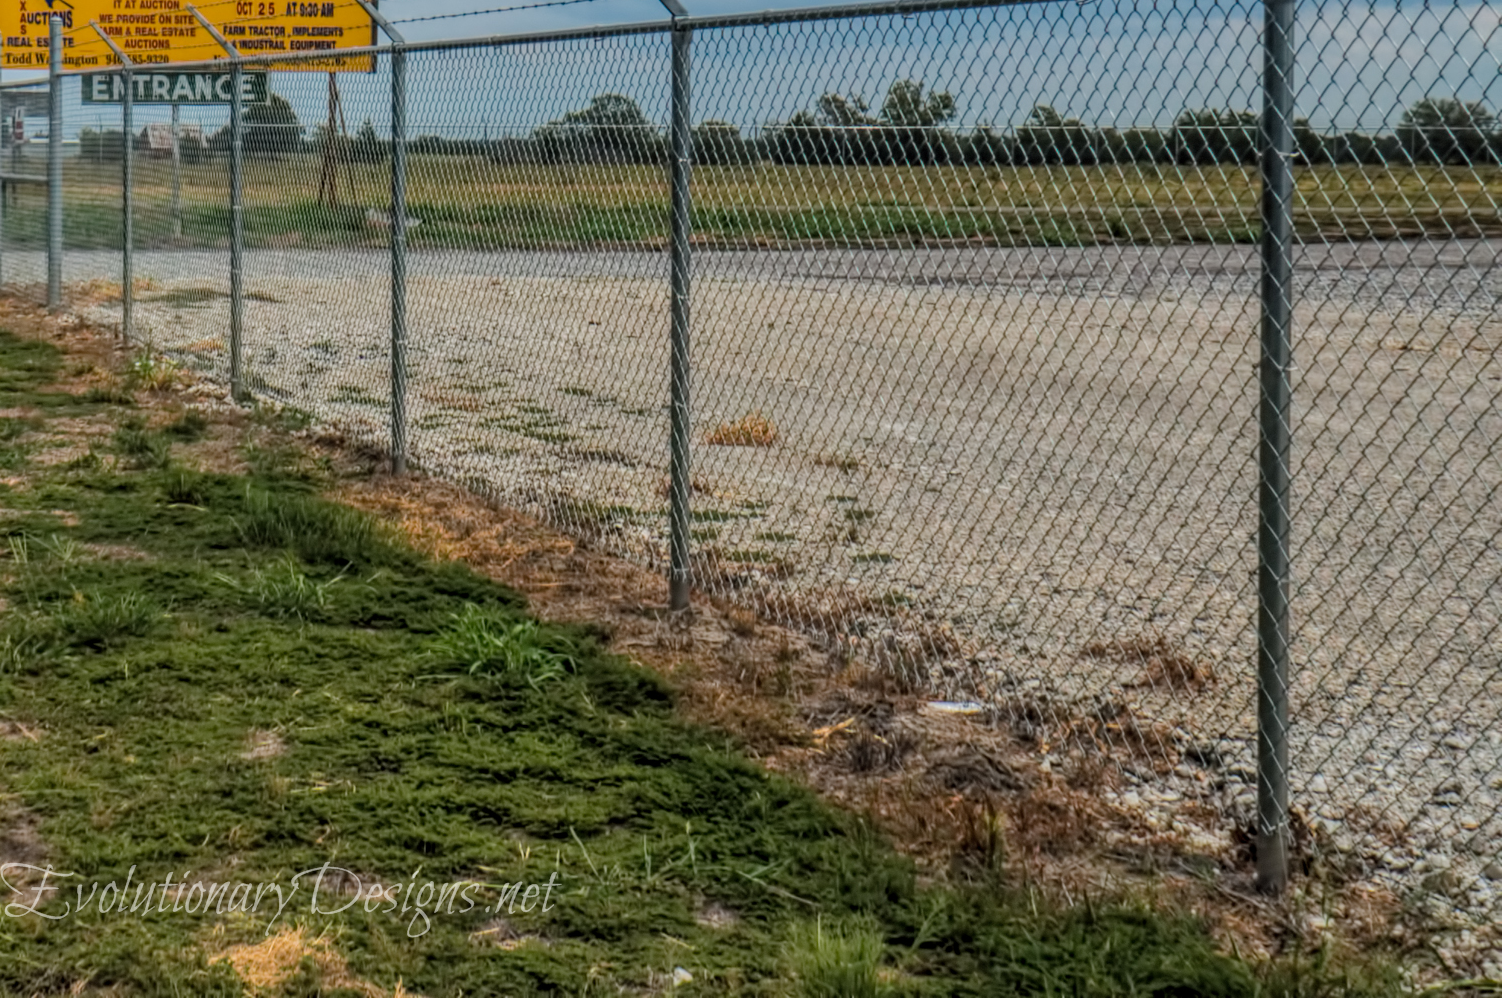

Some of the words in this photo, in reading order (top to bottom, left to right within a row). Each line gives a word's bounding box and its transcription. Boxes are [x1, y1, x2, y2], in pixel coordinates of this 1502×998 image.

[114, 0, 122, 9] IT
[125, 0, 137, 9] AT
[140, 0, 180, 10] AUCTION
[237, 3, 253, 15] OCT
[286, 3, 297, 16] AT
[321, 3, 334, 17] AM
[100, 14, 113, 23] WE
[116, 14, 156, 24] PROVIDE
[159, 15, 172, 24] ON
[175, 15, 195, 24] SITE
[135, 27, 159, 37] REAL
[162, 27, 196, 37] ESTATE
[223, 26, 246, 36] FARM
[293, 27, 344, 37] IMPLEMENTS
[7, 37, 32, 48] REAL
[37, 37, 74, 48] ESTE
[125, 39, 170, 49] AUCTIONS
[290, 40, 336, 50] EQUIPMENT
[6, 53, 32, 64] Todd
[92, 74, 255, 100] ENTRANCE
